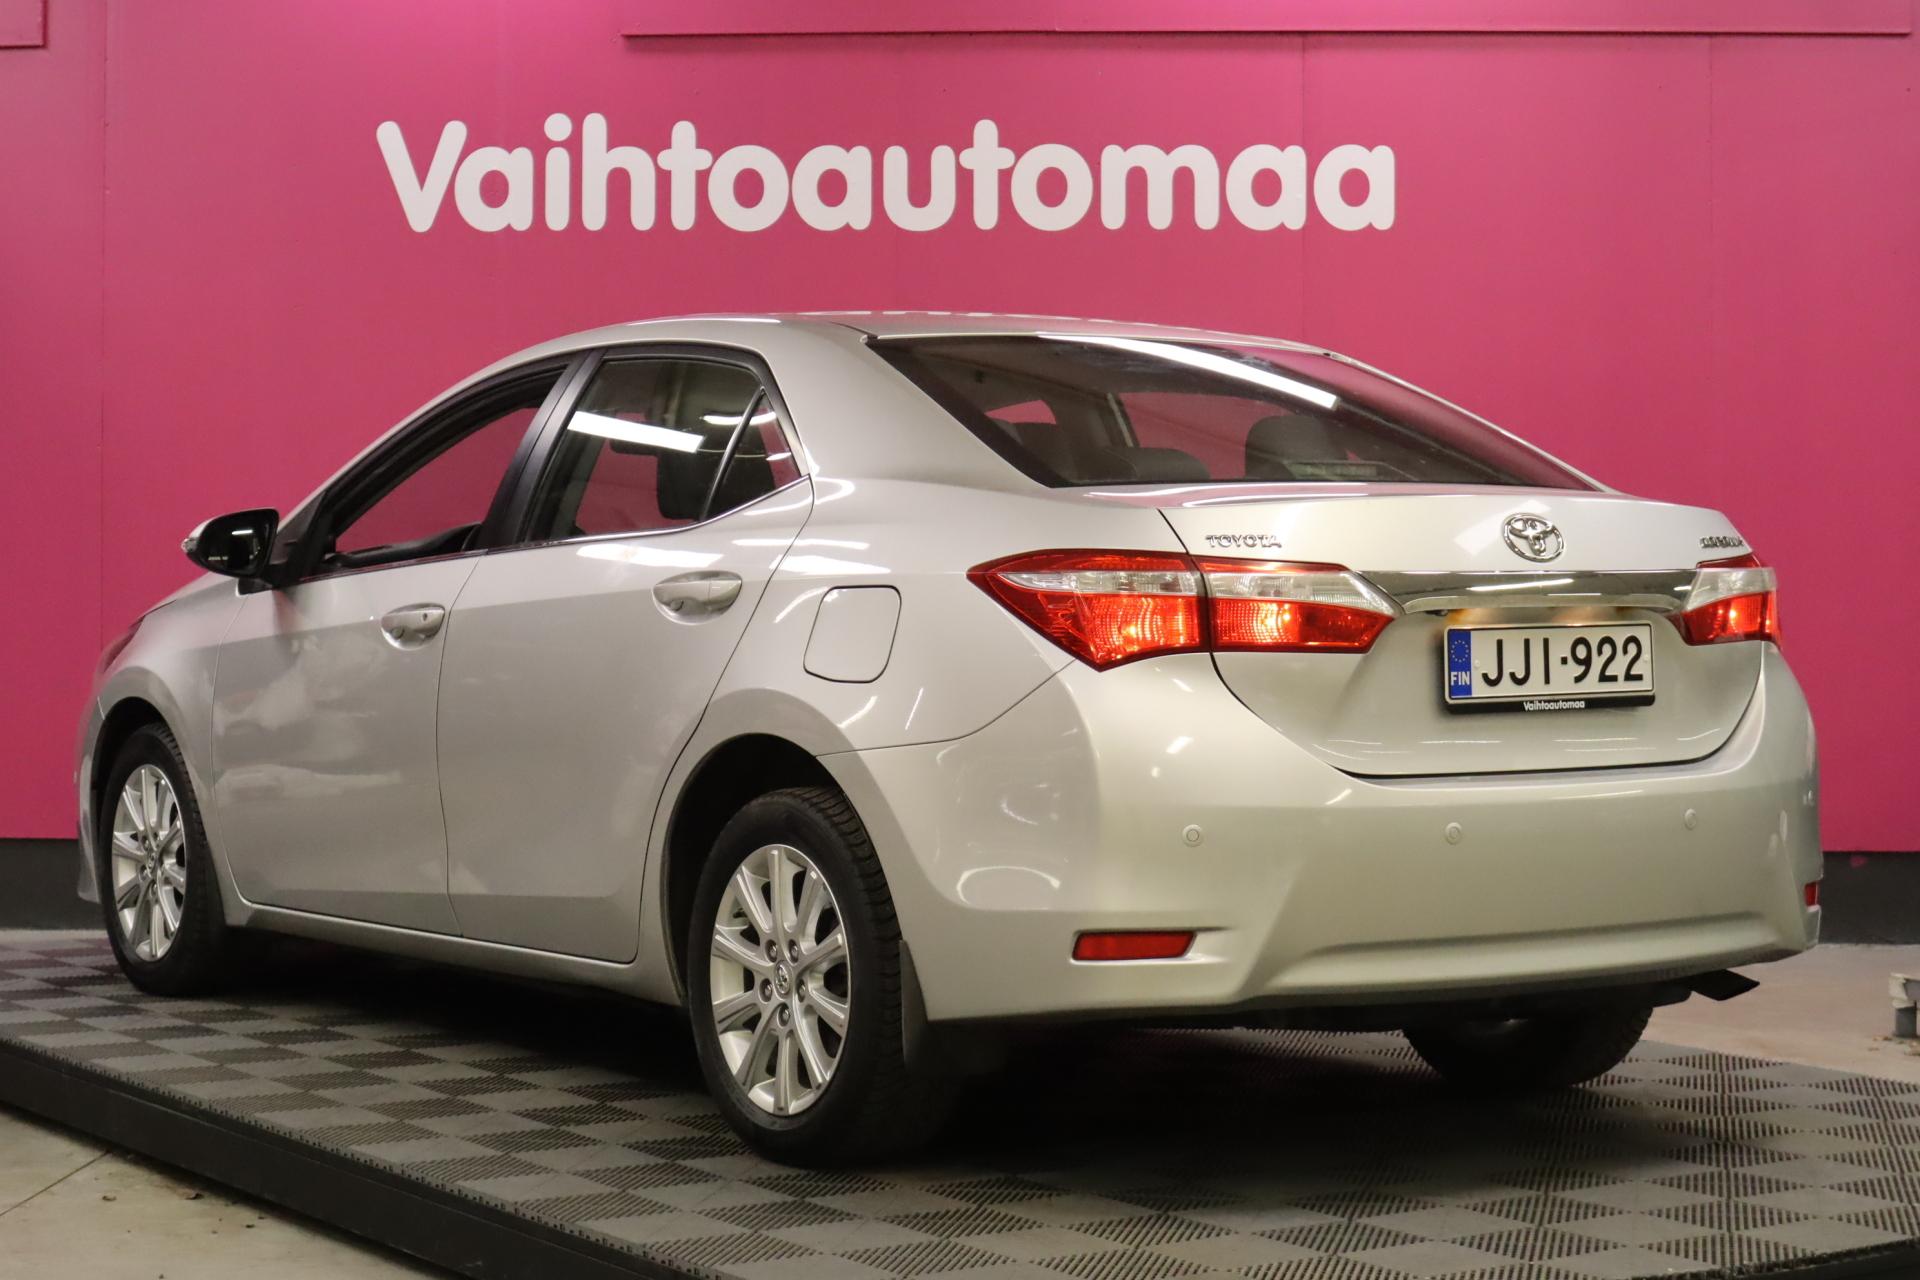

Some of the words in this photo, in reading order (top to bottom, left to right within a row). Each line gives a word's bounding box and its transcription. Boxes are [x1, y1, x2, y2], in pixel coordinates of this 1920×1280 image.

[376, 113, 1395, 232] Vaihtoautomaa
[1205, 534, 1282, 548] TOYOTA
[1450, 671, 1470, 686] FIN
[1523, 700, 1585, 711] Vaihtoautomaa
